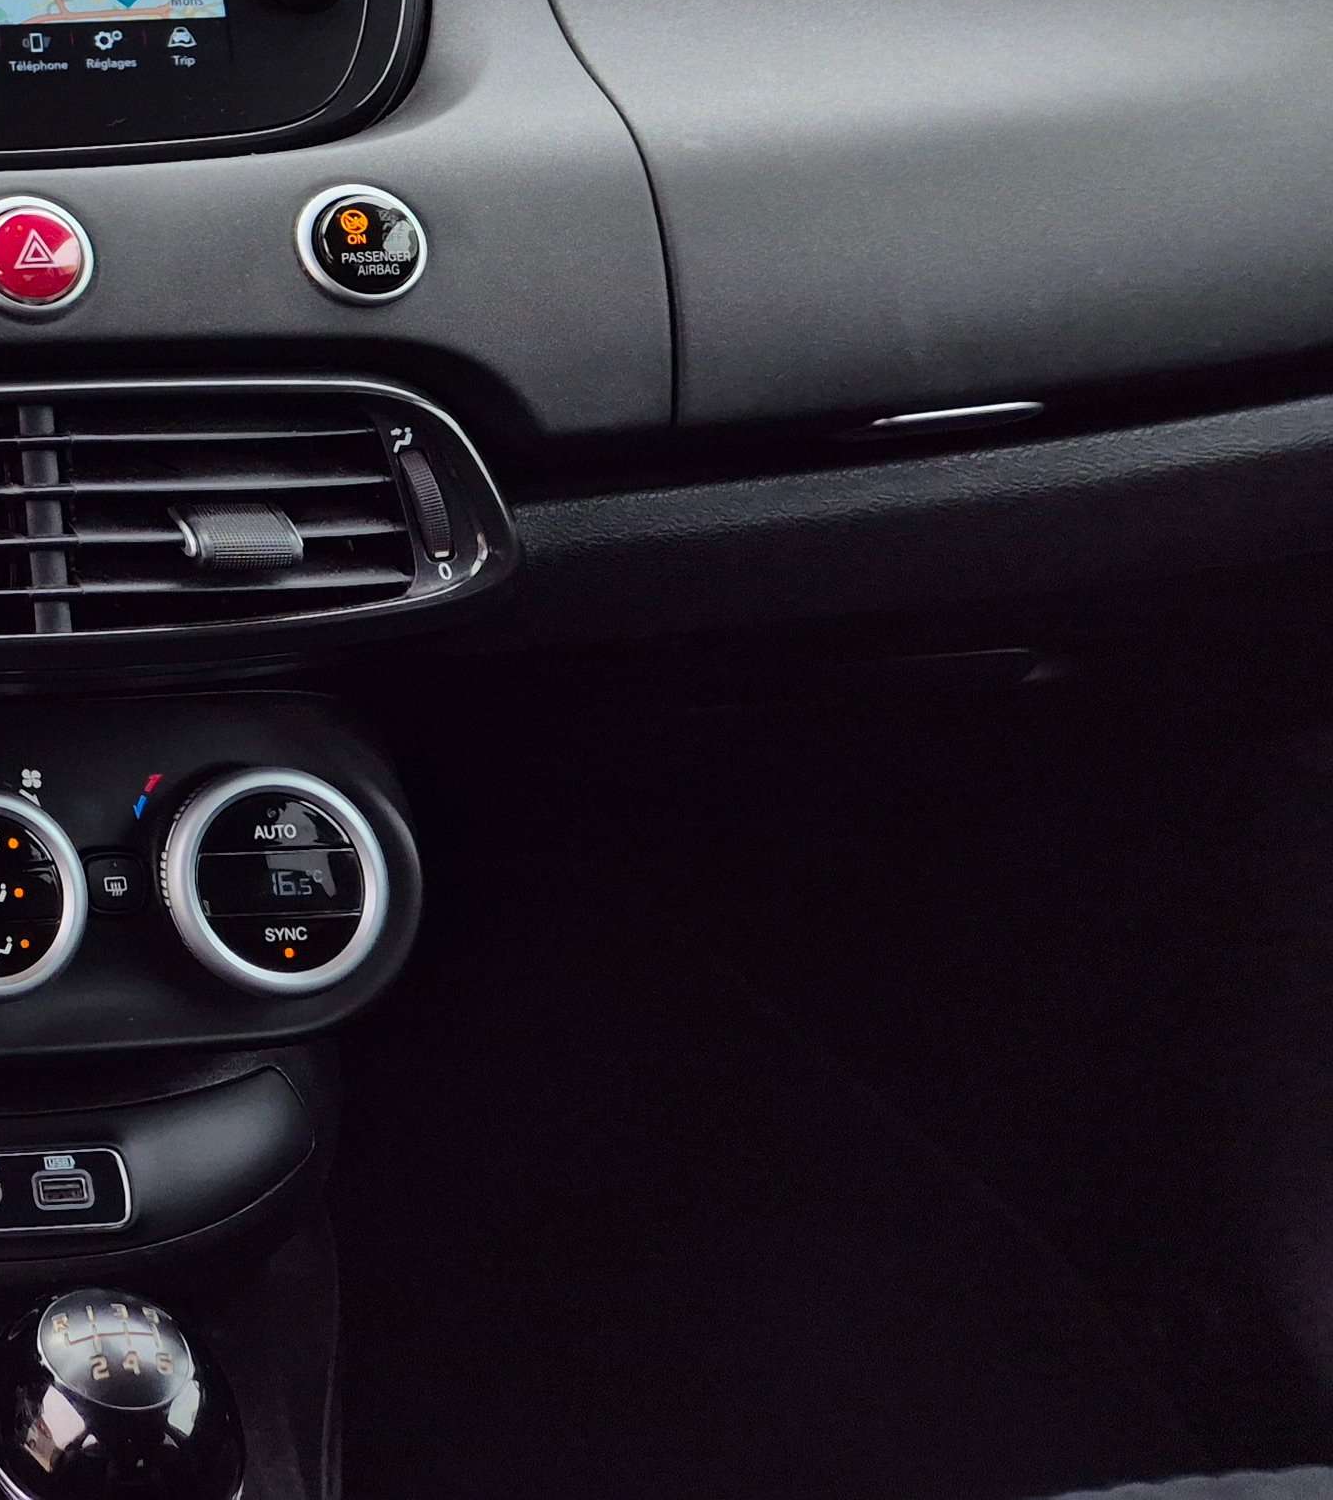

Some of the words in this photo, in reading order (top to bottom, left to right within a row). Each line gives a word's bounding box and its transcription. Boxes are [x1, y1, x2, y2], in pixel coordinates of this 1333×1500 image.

[9, 60, 69, 72] Téléphone
[86, 58, 138, 71] Réglages
[172, 55, 196, 67] Trip
[347, 233, 367, 245] ON
[341, 250, 412, 264] PASSENGER
[357, 263, 400, 277] AIRBAG
[254, 824, 297, 840] AUTO
[264, 927, 308, 943] SYNC
[48, 1158, 70, 1168] USB
[91, 1355, 110, 1380] 2
[122, 1351, 140, 1375] 4
